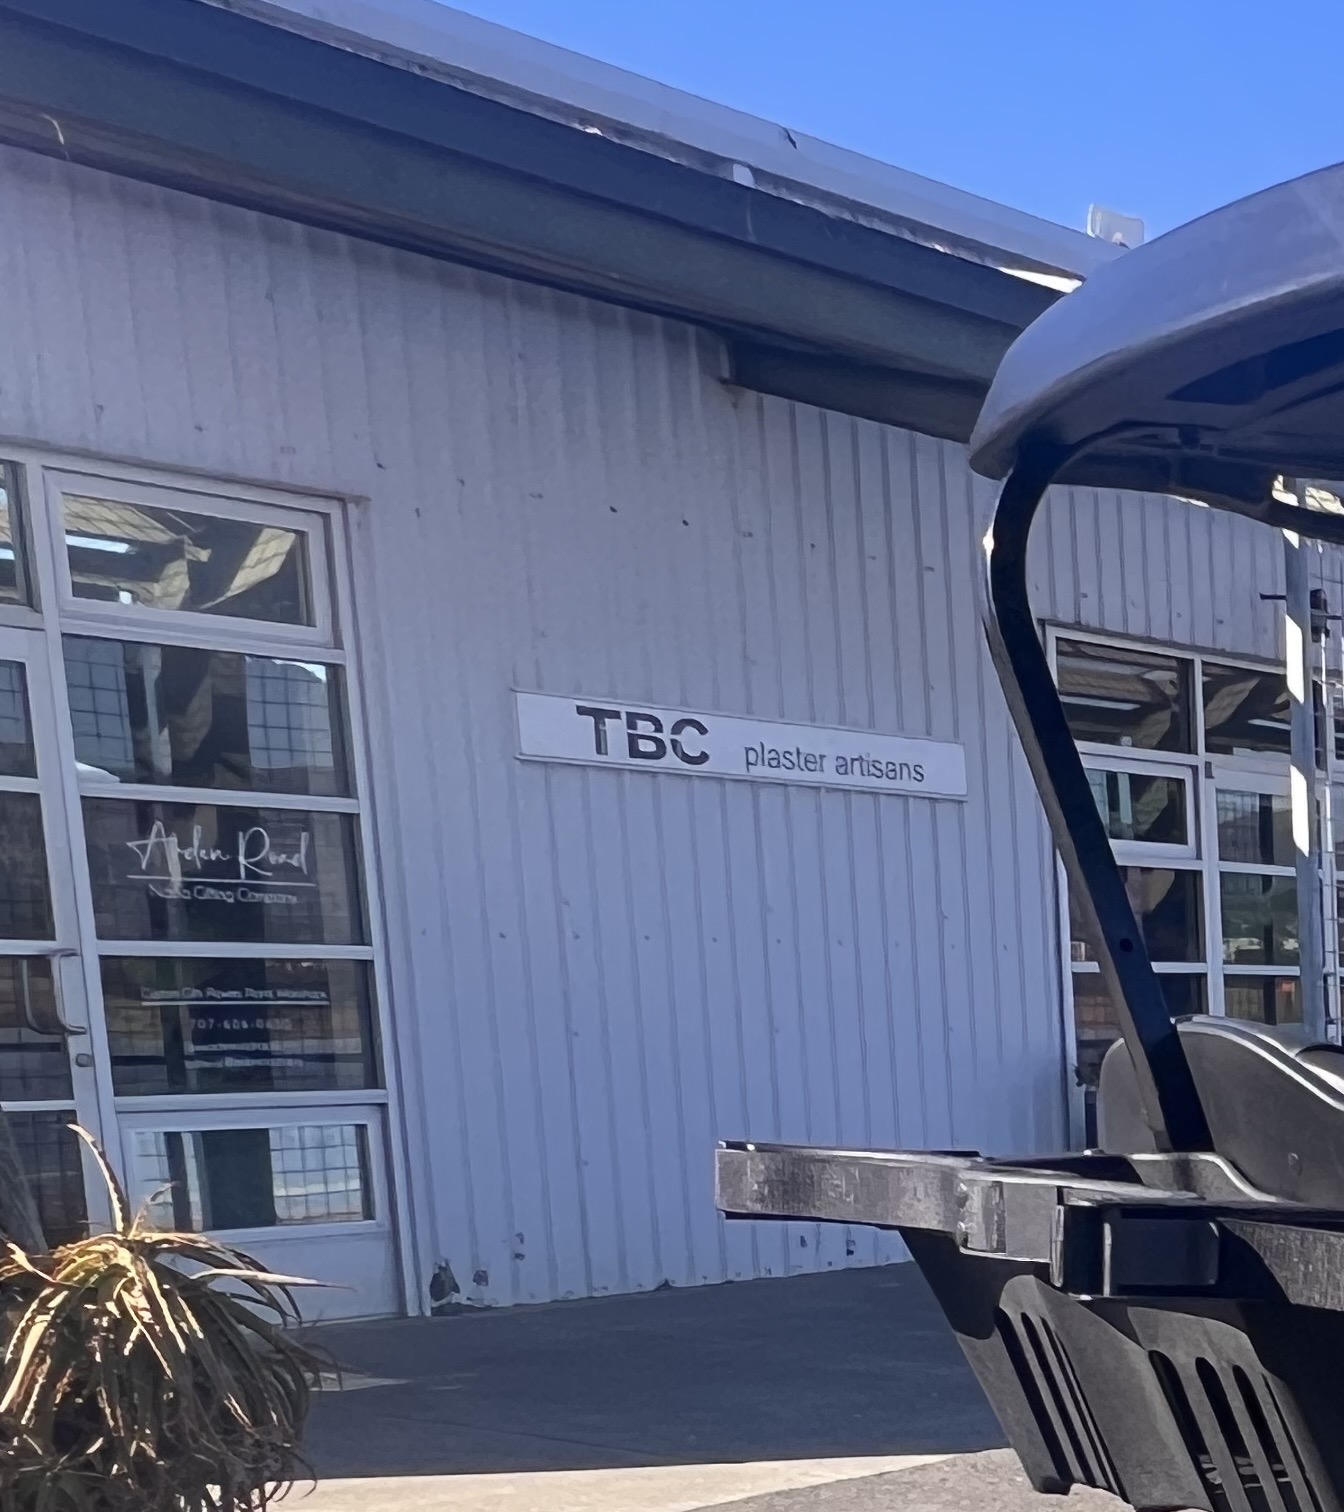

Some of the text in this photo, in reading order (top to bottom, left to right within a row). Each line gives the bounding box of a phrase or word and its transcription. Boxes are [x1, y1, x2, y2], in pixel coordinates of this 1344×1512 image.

[576, 704, 926, 783] TBC plaster artisans
